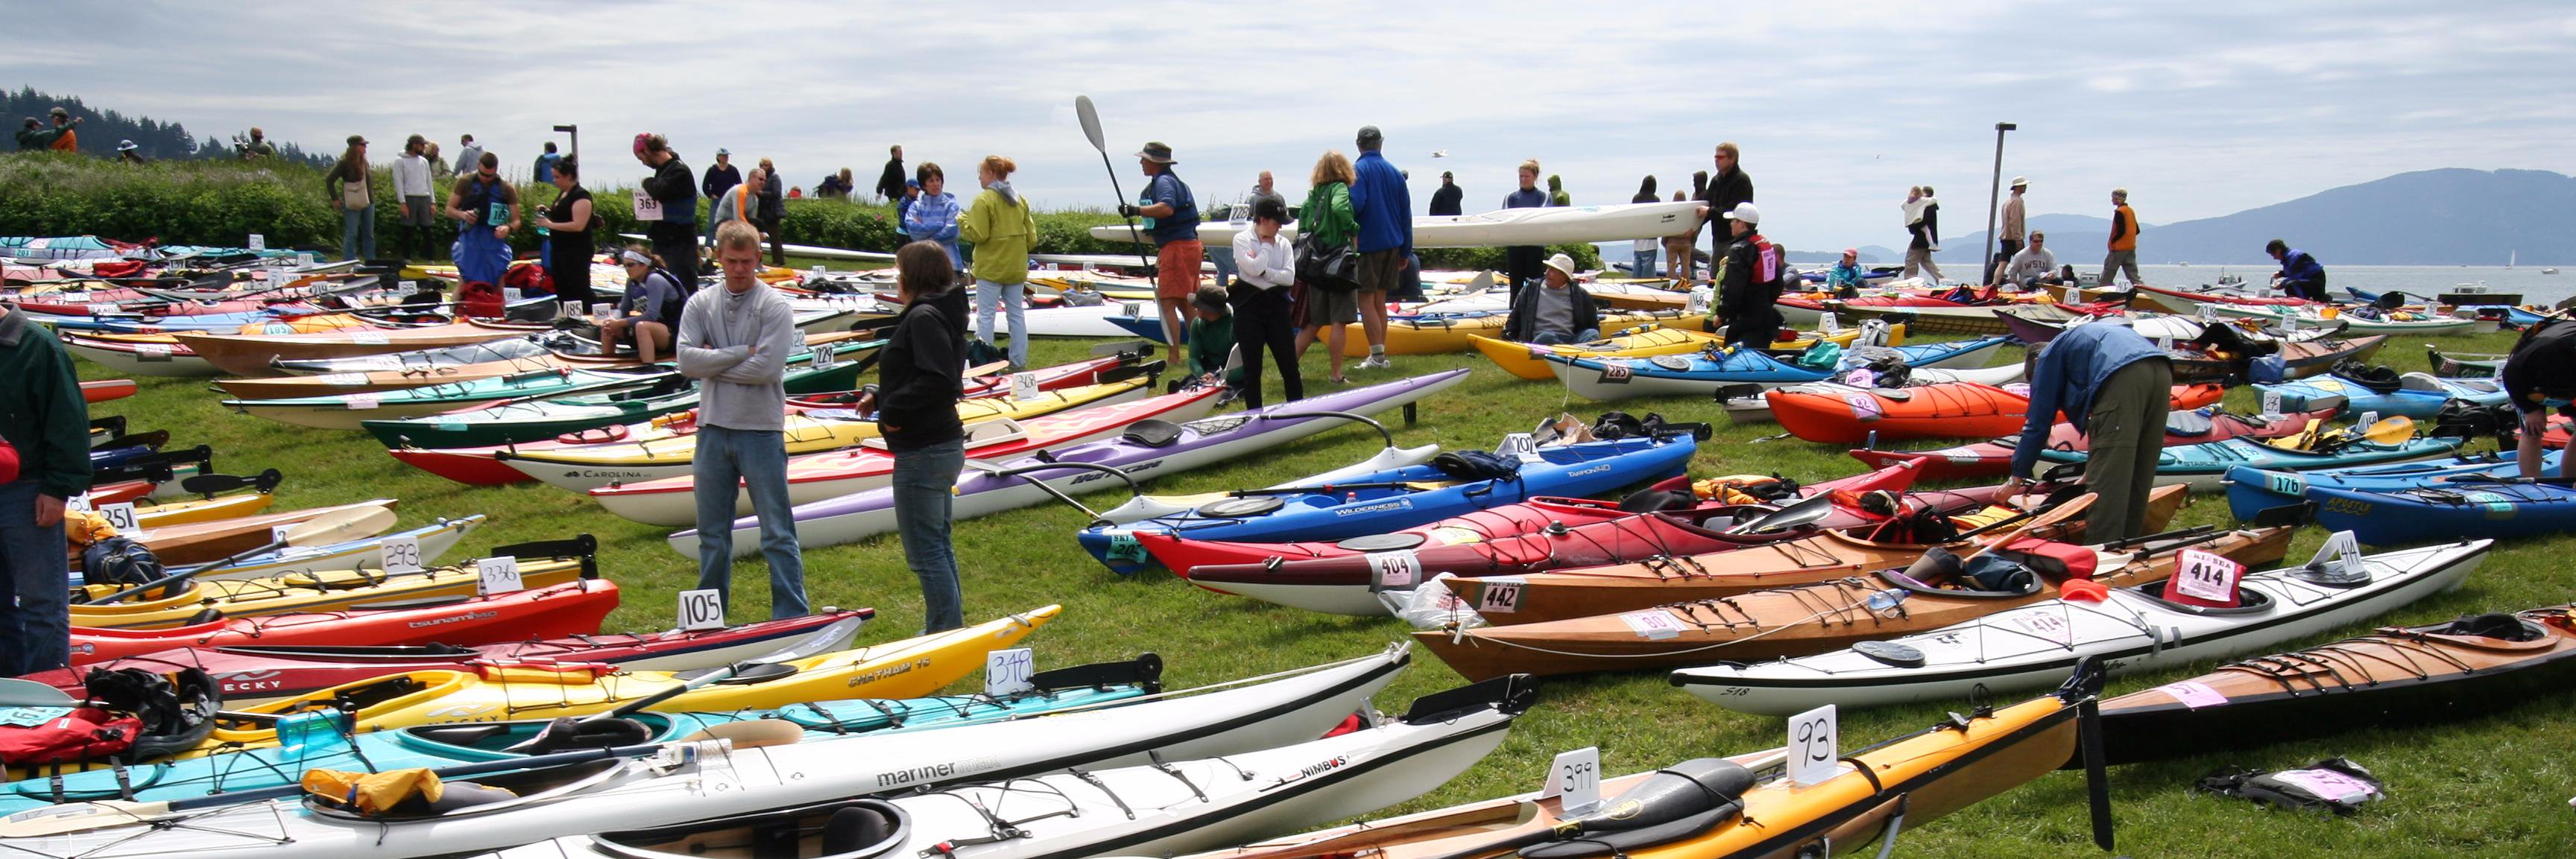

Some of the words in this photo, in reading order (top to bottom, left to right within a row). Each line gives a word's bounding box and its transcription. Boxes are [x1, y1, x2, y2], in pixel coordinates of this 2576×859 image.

[639, 199, 657, 209] 363
[2024, 260, 2046, 270] WSU
[566, 302, 583, 317] 185
[268, 326, 286, 335] 185
[792, 332, 806, 347] 22
[817, 346, 833, 364] 229
[1609, 366, 1627, 378] 285
[1512, 437, 1537, 454] 202
[584, 469, 642, 479] CAROLINA
[1069, 460, 1164, 485] Hurcane
[2276, 476, 2299, 494] 176
[103, 507, 134, 529] 351
[1334, 502, 1400, 517] WILDERNESS
[385, 543, 419, 567] 293
[2340, 540, 2357, 568] 414
[1382, 558, 1409, 575] 404
[2212, 557, 2232, 570] SEA
[486, 564, 517, 583] 336
[2190, 562, 2225, 587] 414
[1486, 586, 1516, 607] 442
[684, 594, 721, 626] 105
[1642, 615, 1668, 629] 80
[847, 662, 913, 688] CHATHAM
[993, 649, 1035, 686] 348
[224, 679, 282, 692] ECKY
[1797, 718, 1830, 769] 93
[877, 761, 956, 787] mariner
[1300, 755, 1347, 778] NIMBUS
[1563, 761, 1593, 793] 399
